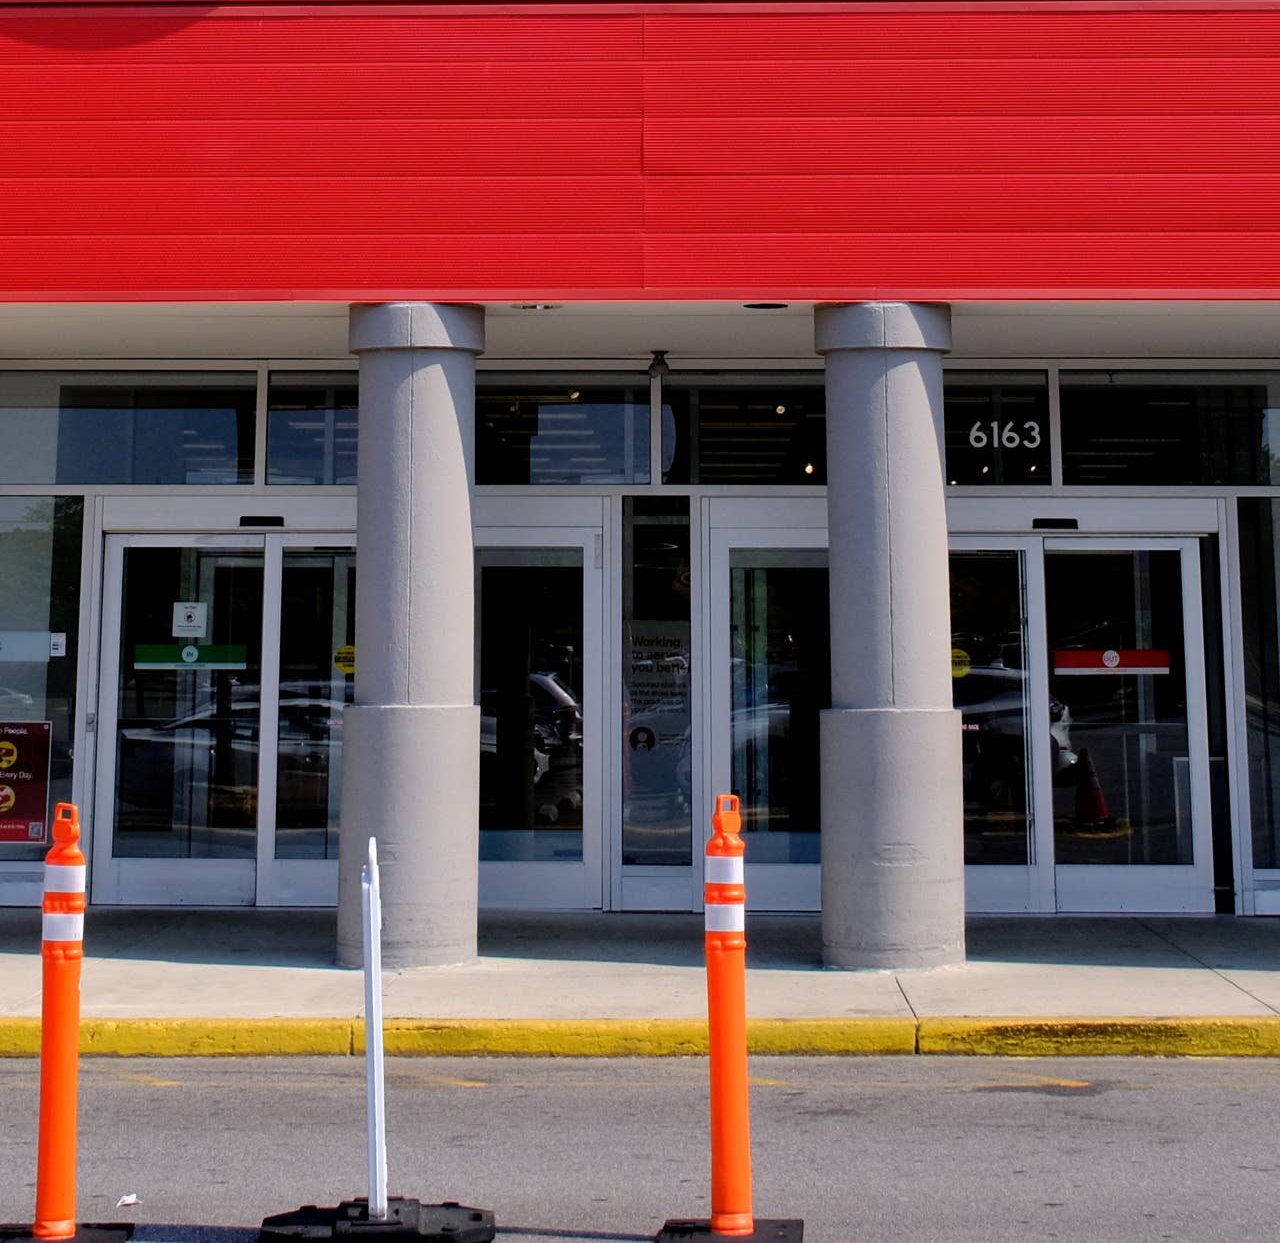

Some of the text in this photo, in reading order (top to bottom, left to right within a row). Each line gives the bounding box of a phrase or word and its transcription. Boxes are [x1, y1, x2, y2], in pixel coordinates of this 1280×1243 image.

[969, 420, 1041, 448] 6163
[631, 636, 681, 649] Working
[631, 663, 653, 675] you
[0, 771, 18, 781] Every
